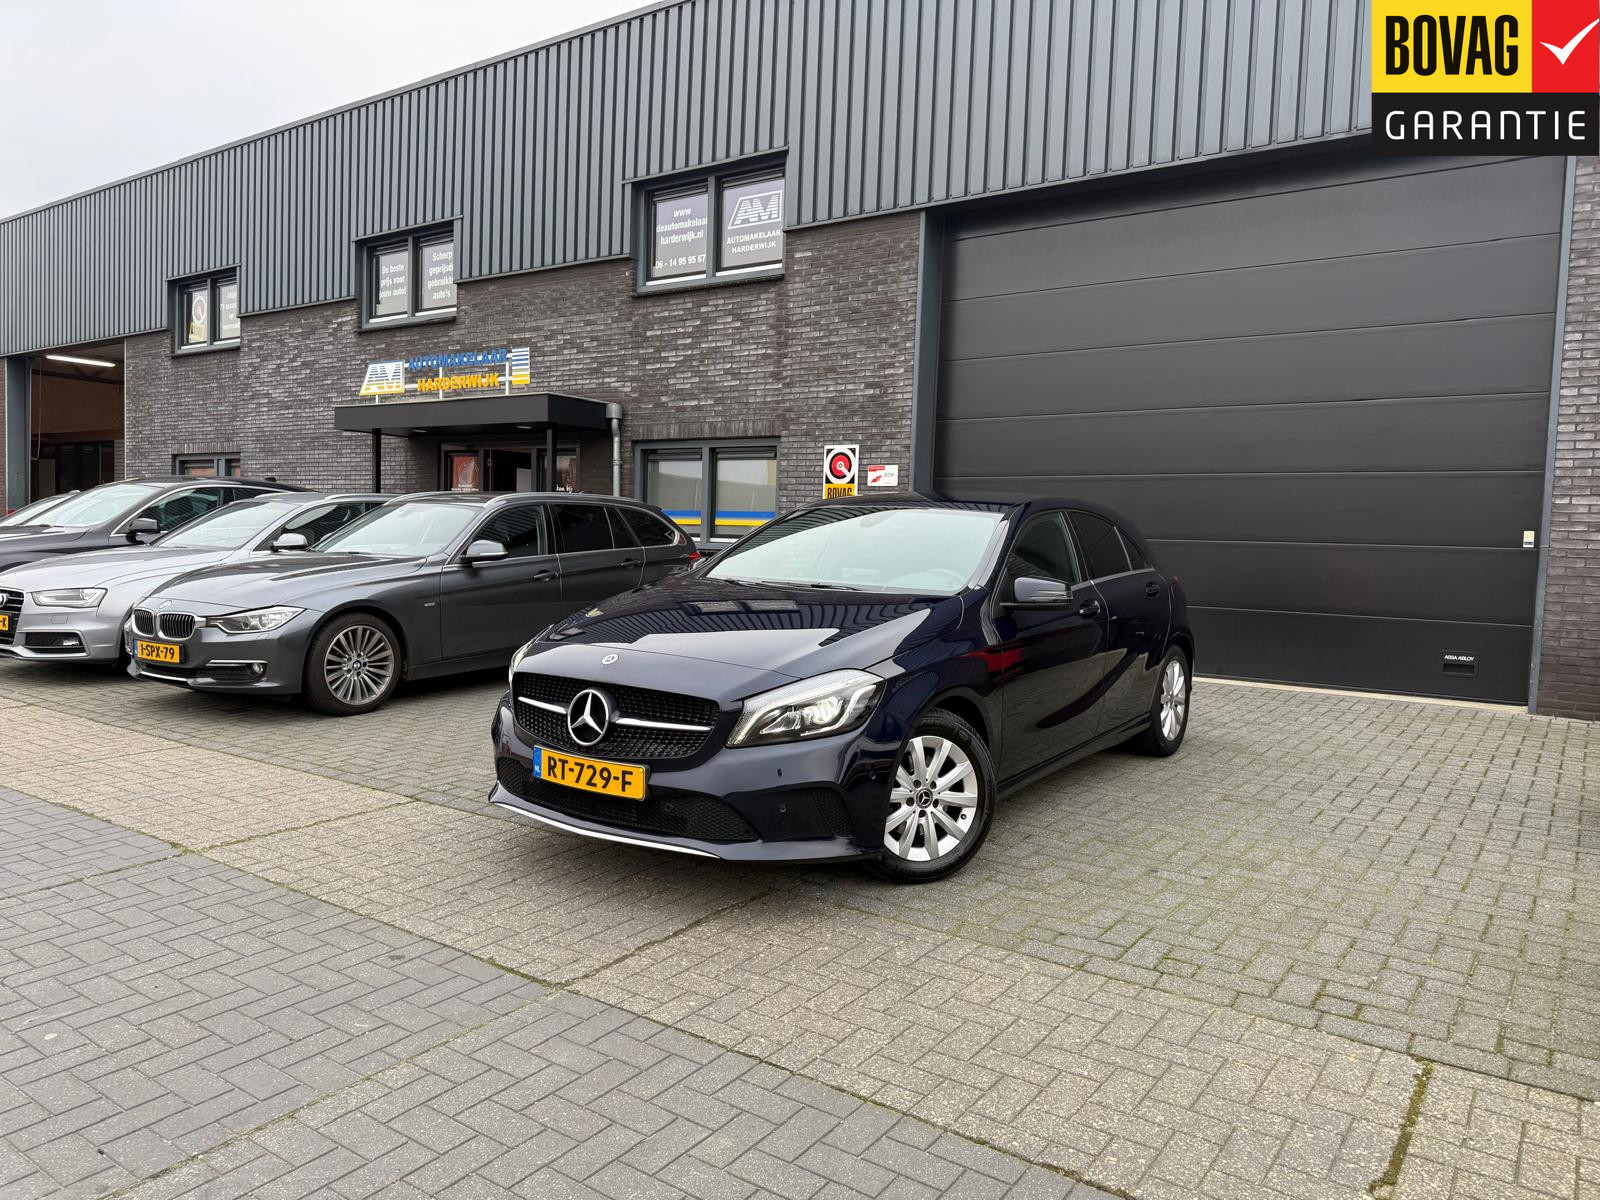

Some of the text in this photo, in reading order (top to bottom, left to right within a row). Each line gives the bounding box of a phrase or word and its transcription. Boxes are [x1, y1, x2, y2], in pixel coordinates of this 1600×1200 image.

[673, 208, 692, 218] www
[660, 229, 704, 246] harderwijk.nl
[726, 229, 781, 245] AUTOMAKELAAR
[731, 240, 777, 254] HARDERWIJK
[669, 257, 677, 267] 14
[678, 256, 687, 266] 95
[687, 255, 697, 264] 95
[697, 254, 706, 263] 67
[390, 264, 405, 273] beste
[432, 289, 452, 300] auto's
[408, 349, 508, 370] AUTOMAKELAAR
[417, 374, 500, 392] HARDERWIJK
[827, 487, 852, 499] BOVAG
[141, 644, 175, 660] 1-SPX-79
[534, 755, 633, 792] NL RT-729-F
